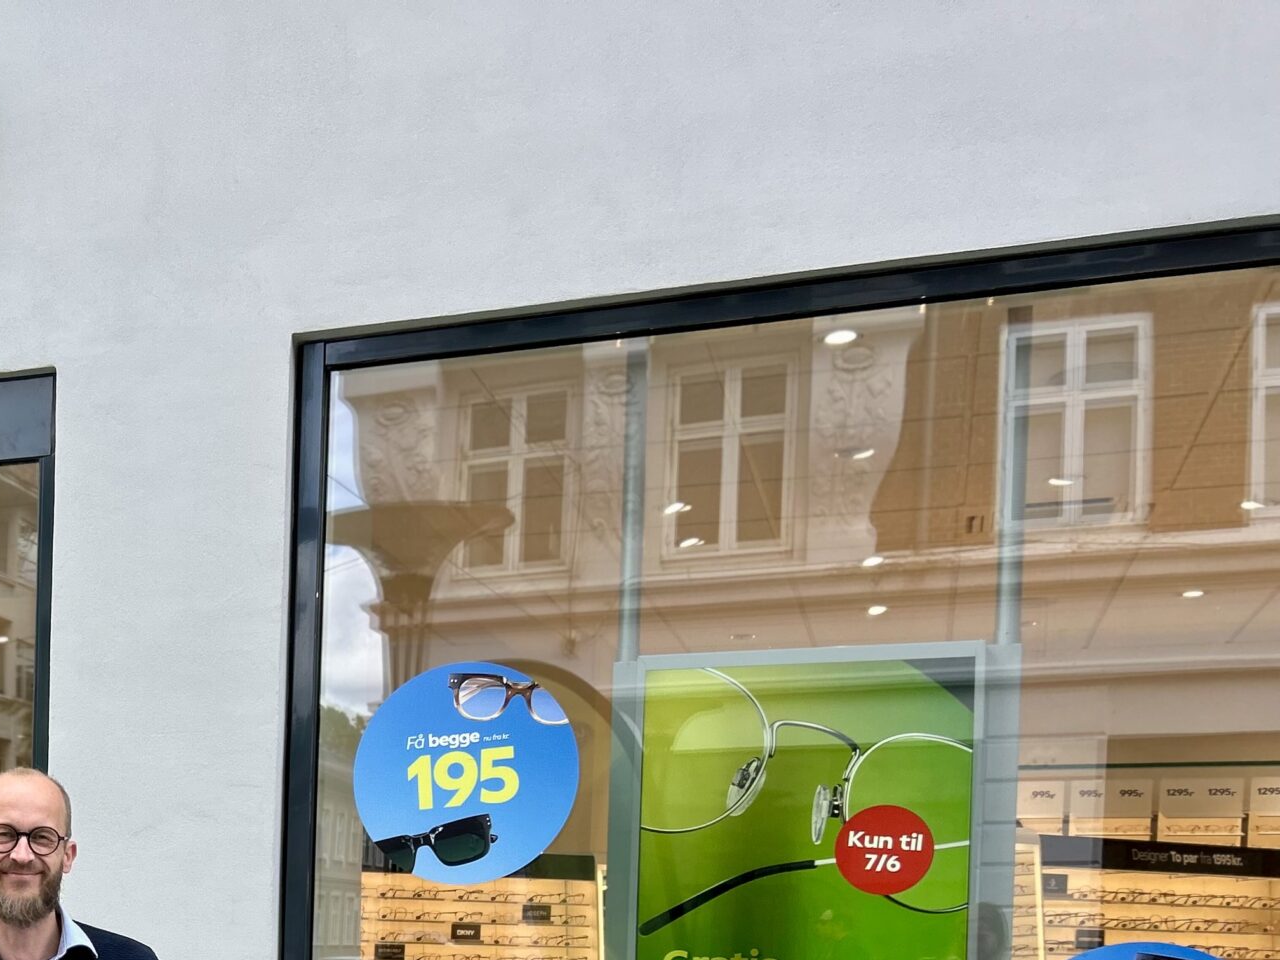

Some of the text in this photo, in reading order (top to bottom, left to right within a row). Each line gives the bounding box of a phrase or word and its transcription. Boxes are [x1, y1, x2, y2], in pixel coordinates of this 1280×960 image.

[406, 733, 425, 750] Få
[428, 732, 480, 748] begge
[407, 745, 520, 811] 195
[848, 830, 924, 852] Kun til
[864, 853, 901, 873] 7/6
